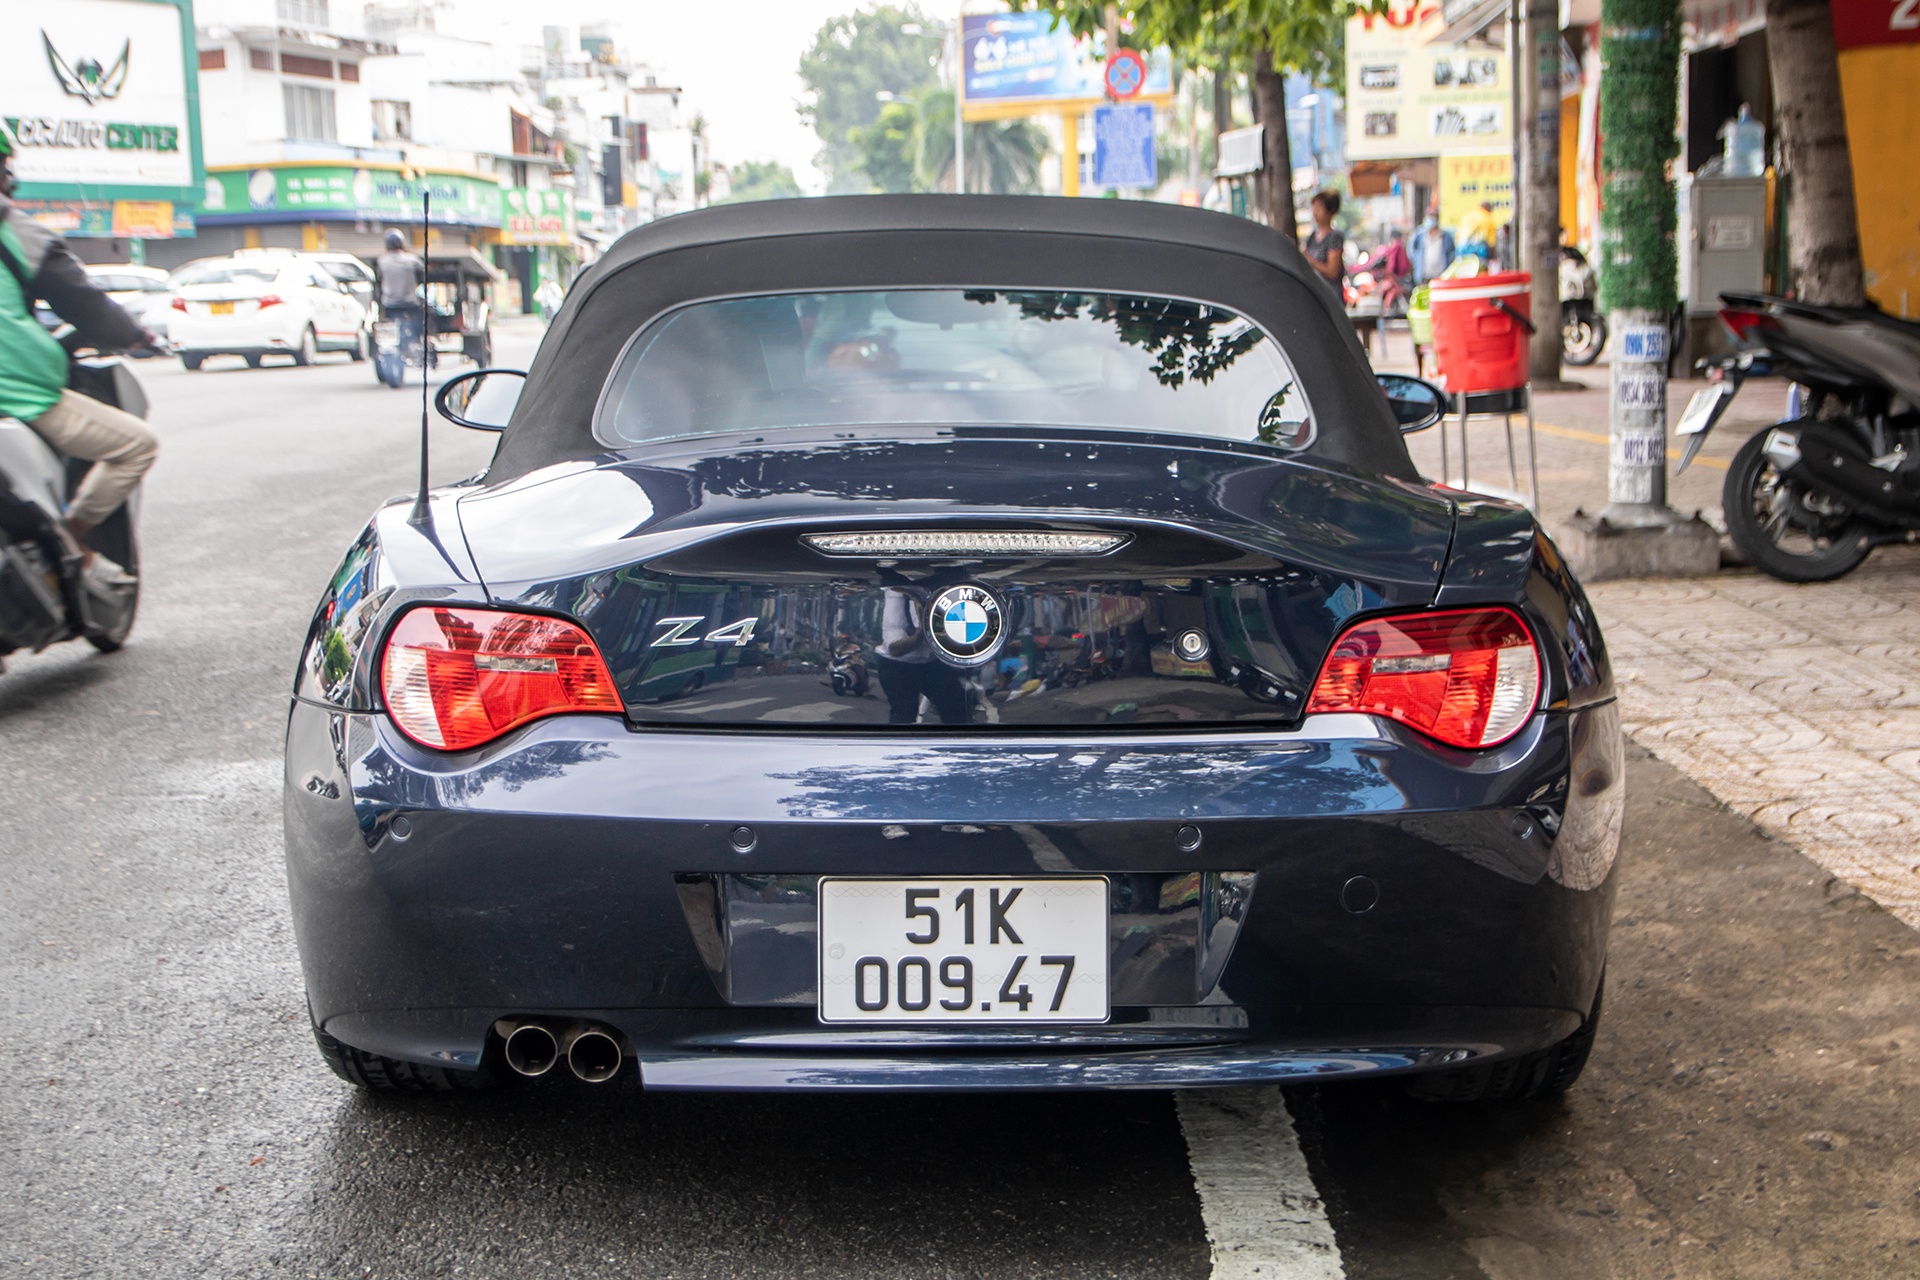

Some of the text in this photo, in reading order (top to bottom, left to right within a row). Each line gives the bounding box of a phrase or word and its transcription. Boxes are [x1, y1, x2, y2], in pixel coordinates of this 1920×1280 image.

[938, 588, 996, 612] BMW
[650, 615, 758, 647] Z4
[905, 887, 1024, 945] 51K
[855, 955, 1075, 1012] 009.47
